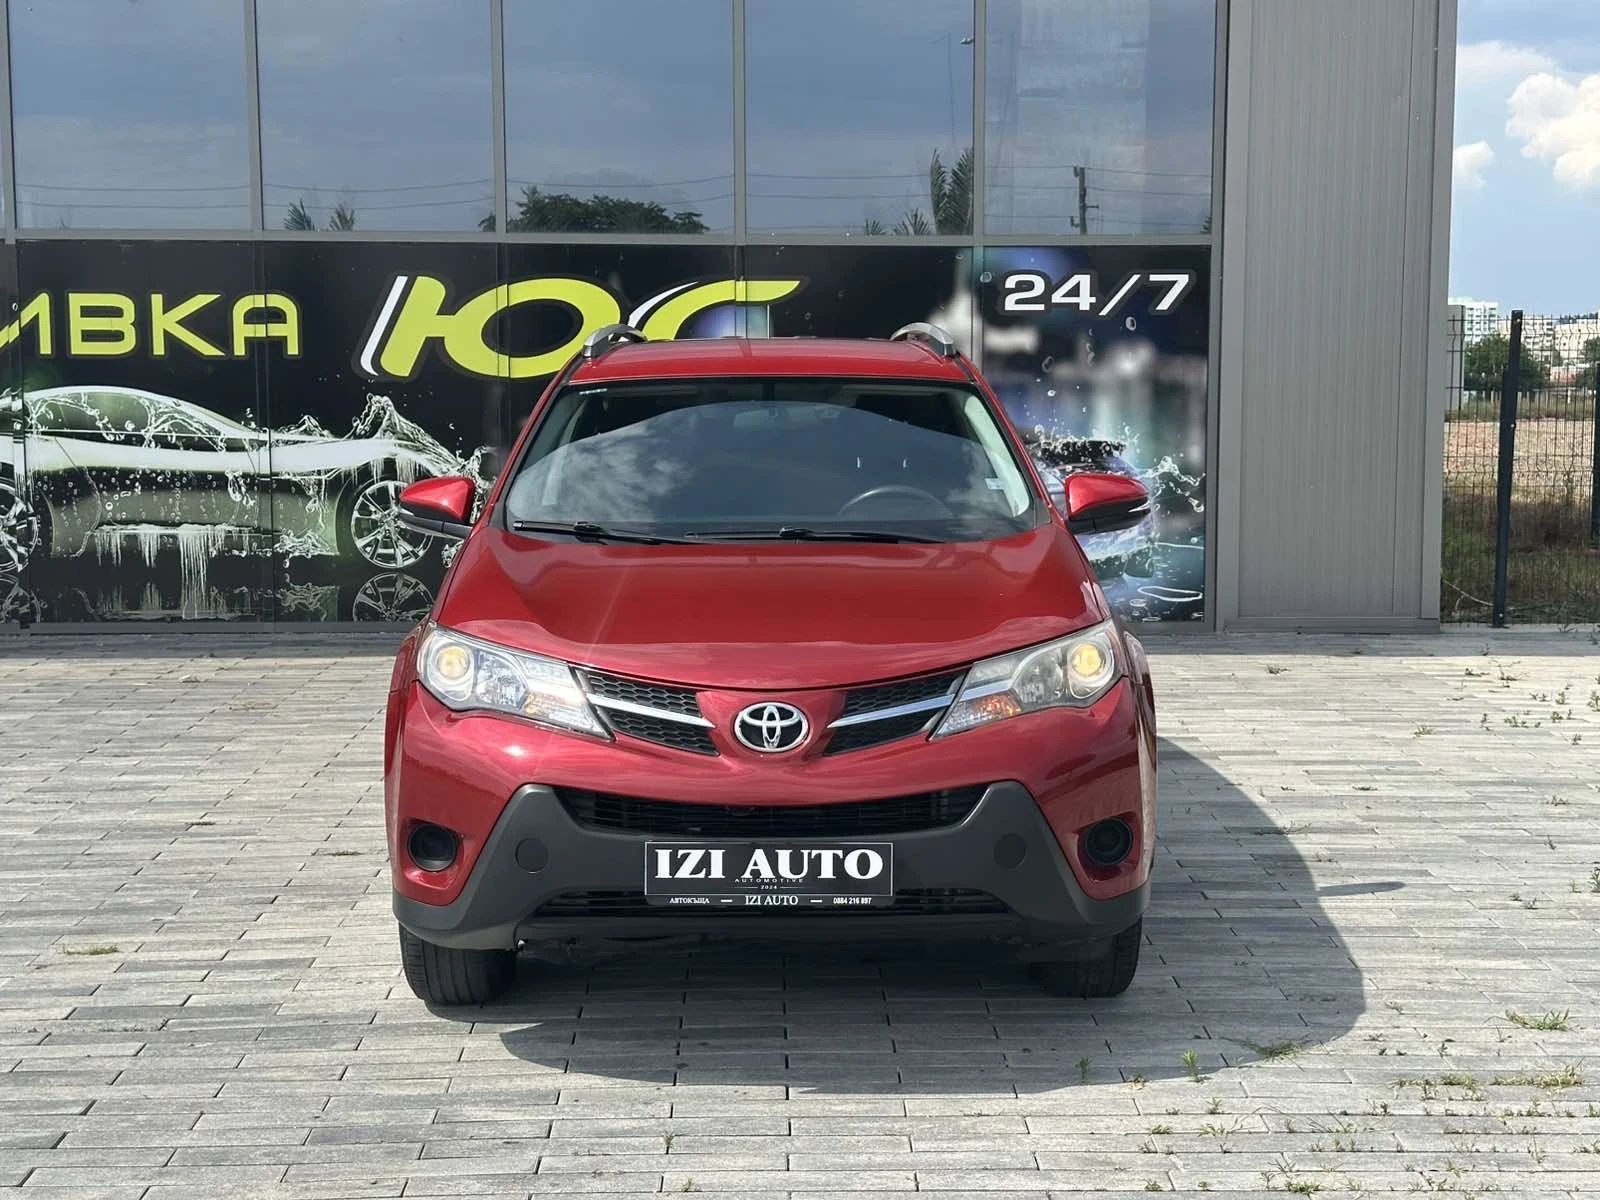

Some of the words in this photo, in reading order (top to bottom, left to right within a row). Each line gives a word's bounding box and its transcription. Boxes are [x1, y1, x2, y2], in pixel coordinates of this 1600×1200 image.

[1004, 272, 1190, 317] 24/7
[655, 849, 726, 879] IZI
[741, 848, 884, 880] AUTO
[745, 895, 761, 905] IZI
[764, 895, 798, 905] AUTO
